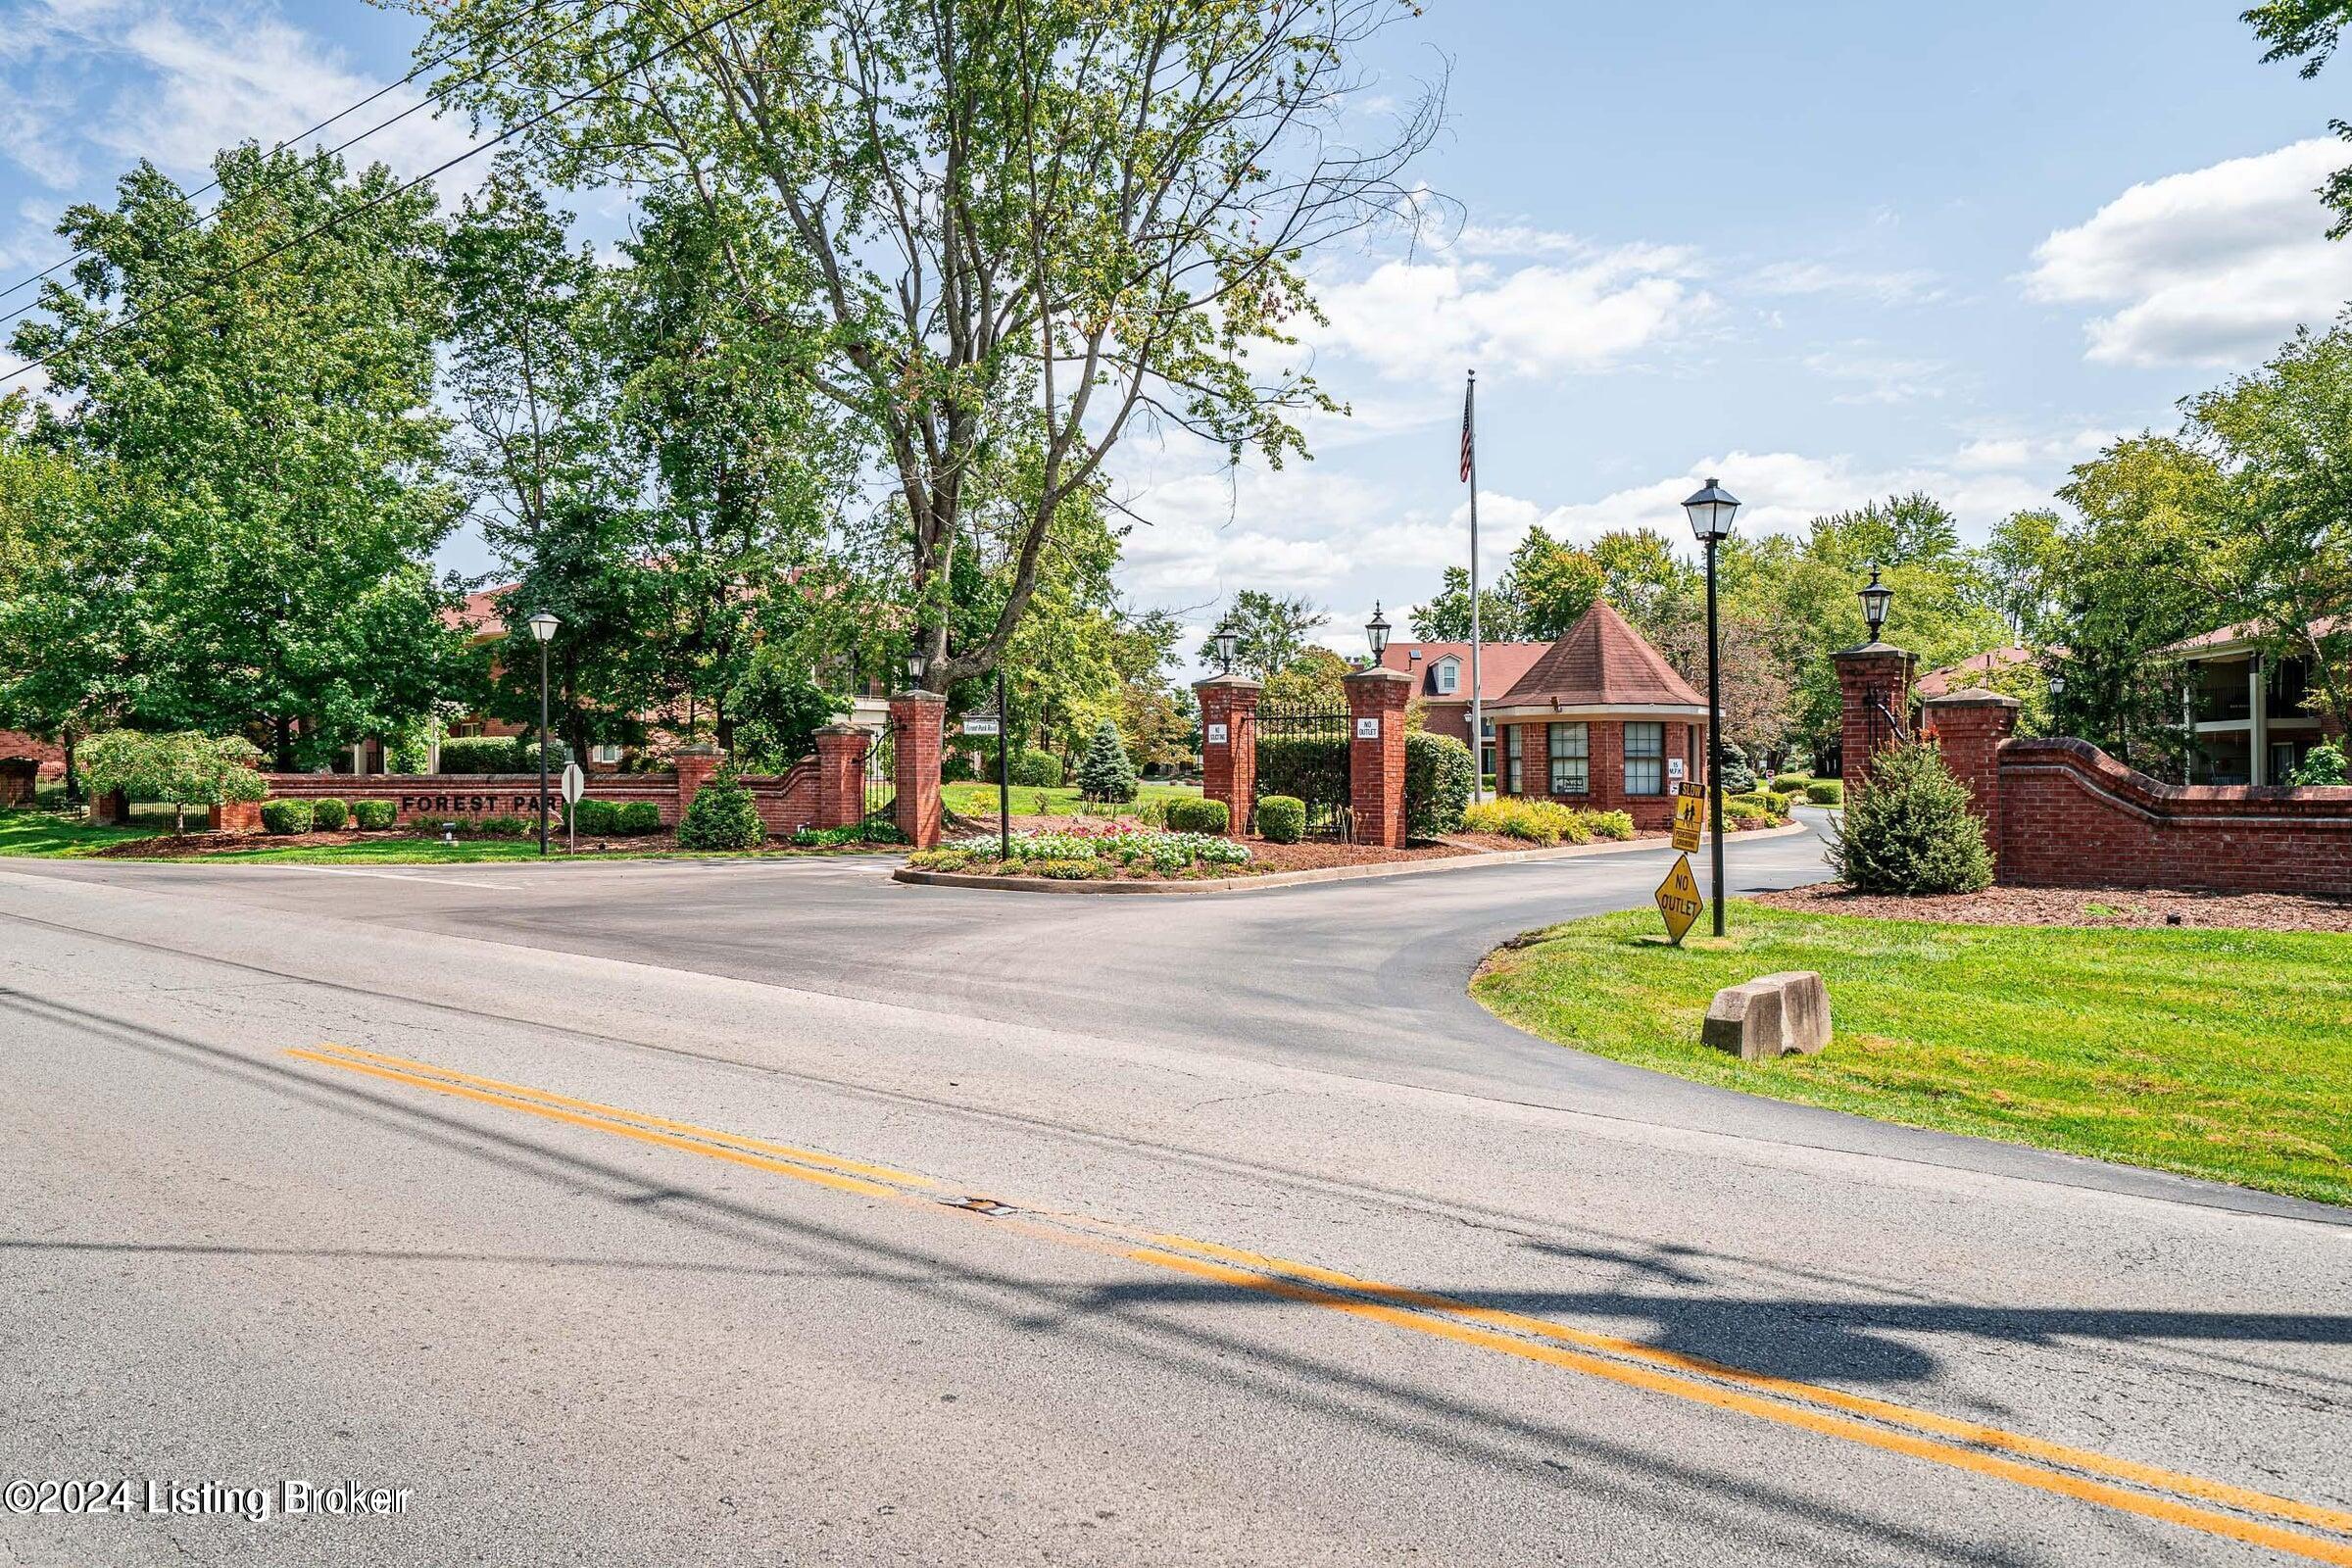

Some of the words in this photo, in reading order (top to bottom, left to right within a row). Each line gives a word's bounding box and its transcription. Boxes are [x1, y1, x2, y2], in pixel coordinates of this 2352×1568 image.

[1682, 783, 1703, 797] SLOW
[402, 796, 498, 812] FOREST
[514, 796, 566, 811] PAR
[1676, 873, 1689, 891] NO
[1661, 894, 1697, 917] OUTLET
